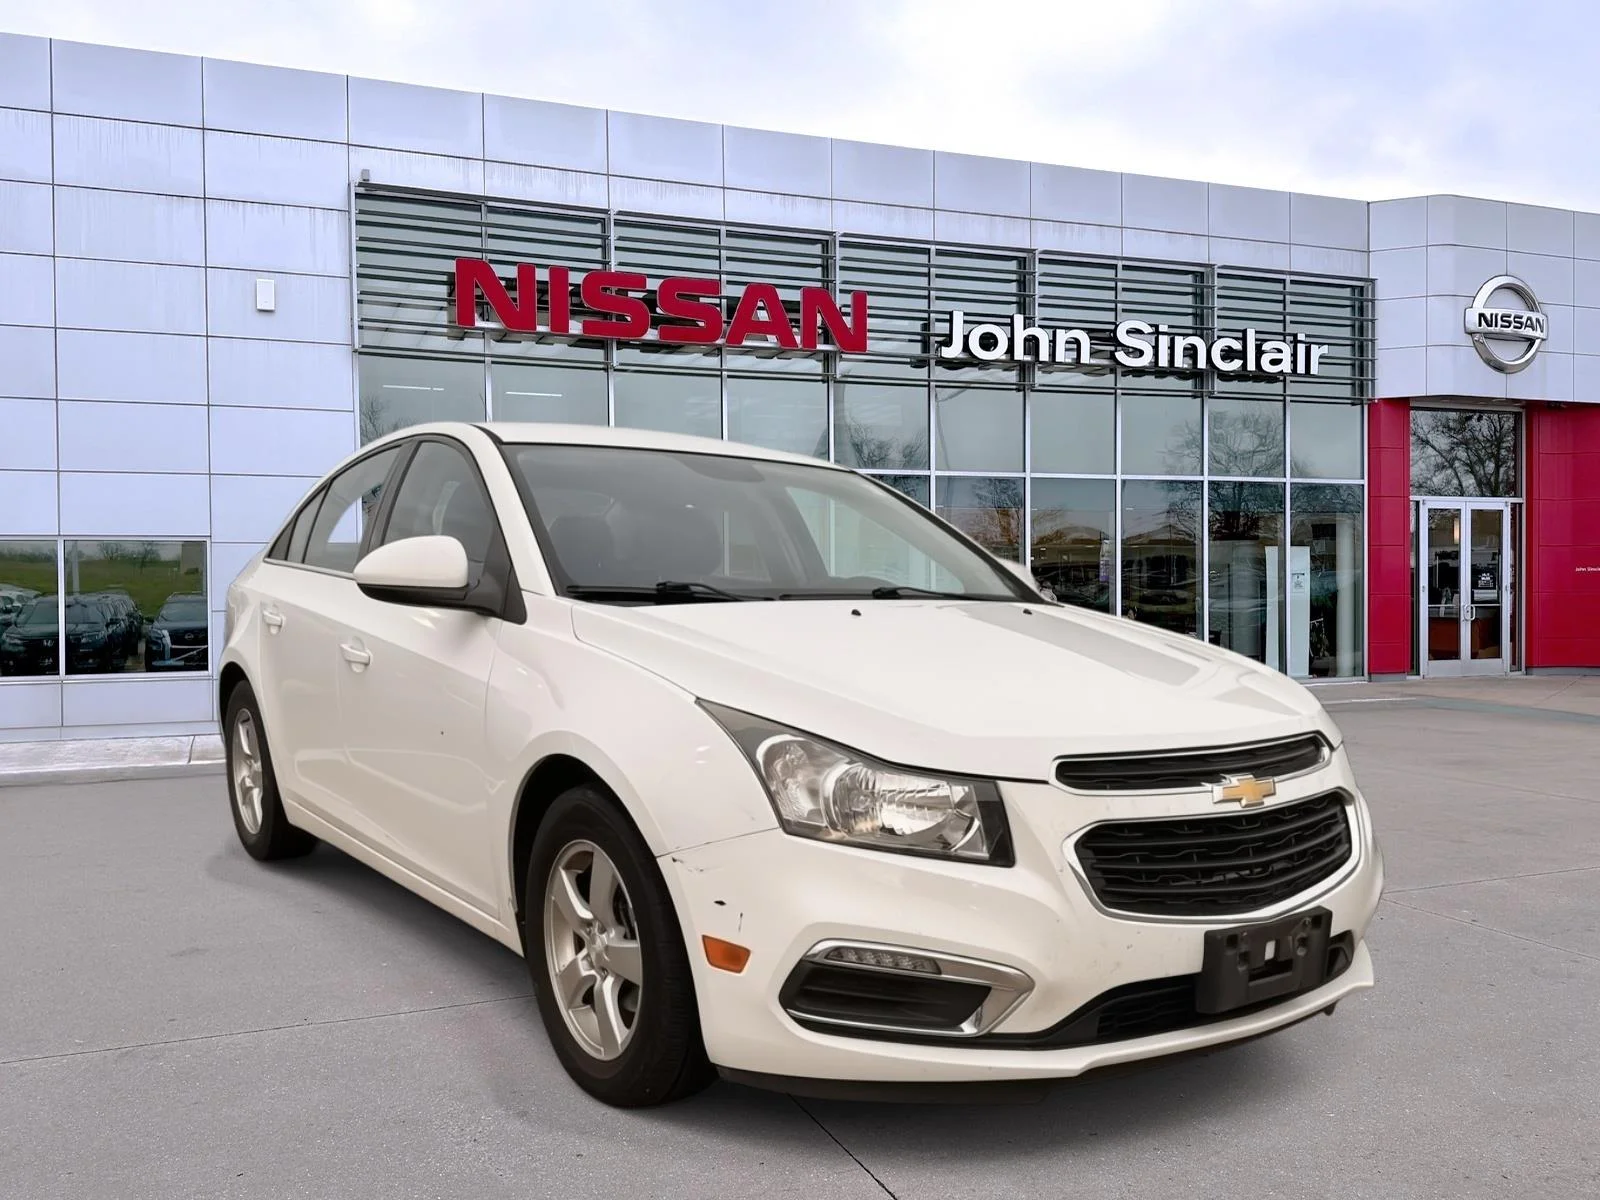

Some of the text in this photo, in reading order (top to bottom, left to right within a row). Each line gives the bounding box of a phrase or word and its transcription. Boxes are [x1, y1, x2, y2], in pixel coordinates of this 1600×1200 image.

[455, 257, 868, 353] NISSAN
[1477, 312, 1545, 333] NISSAN
[939, 310, 1329, 375] John Sinclair
